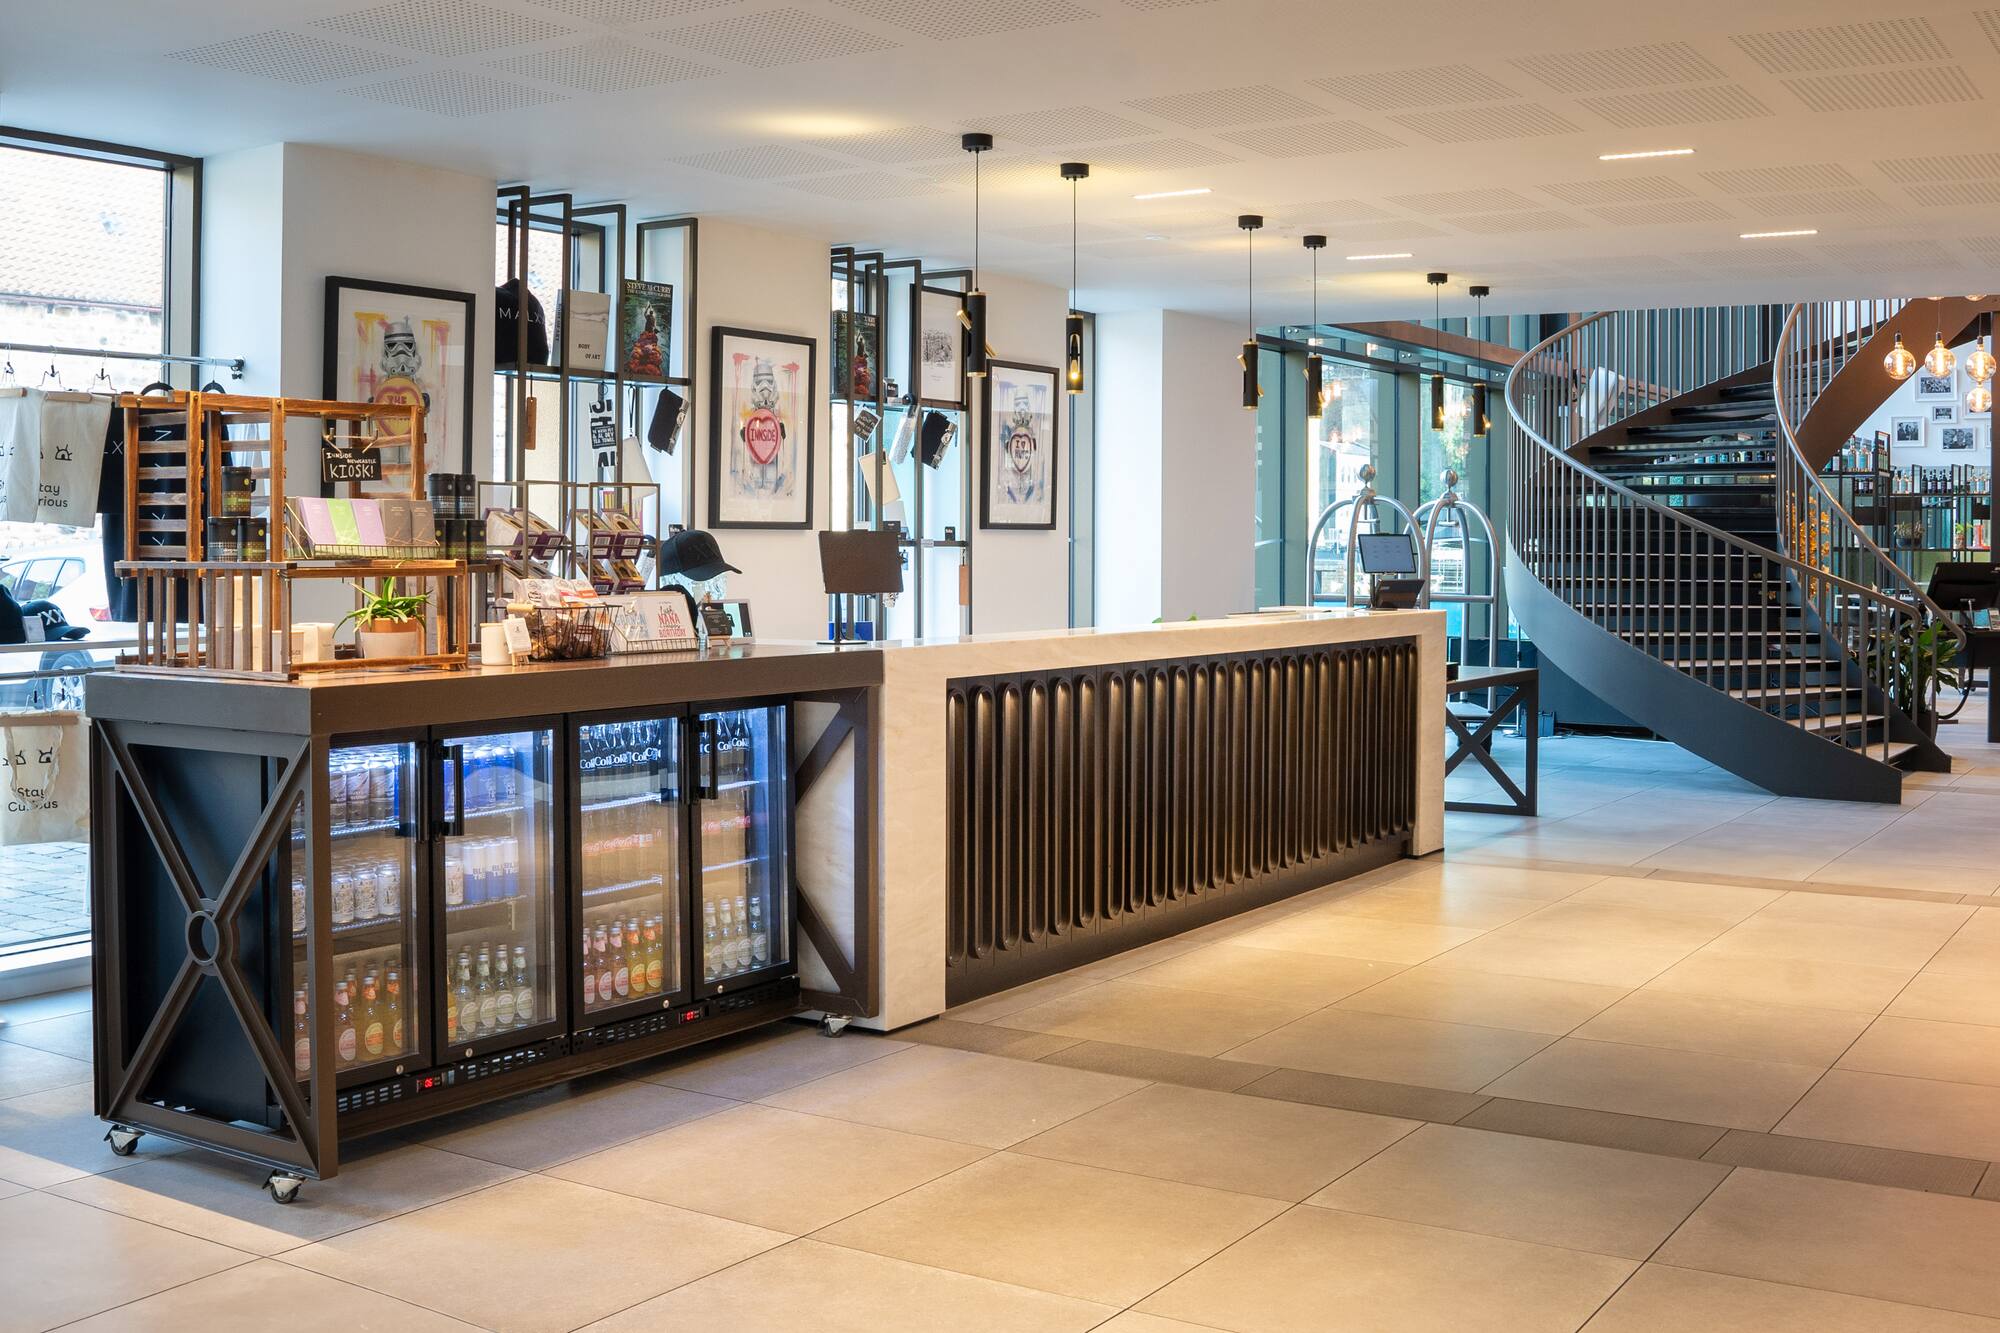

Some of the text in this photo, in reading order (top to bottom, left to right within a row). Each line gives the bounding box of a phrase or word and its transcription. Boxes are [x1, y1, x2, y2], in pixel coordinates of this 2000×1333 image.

[626, 282, 646, 291] STEVE
[329, 463, 374, 479] KIOSK!
[39, 483, 60, 496] tay
[38, 496, 68, 508] rious
[658, 612, 681, 625] NANA
[17, 786, 46, 799] Stay
[8, 800, 58, 812] Cuus
